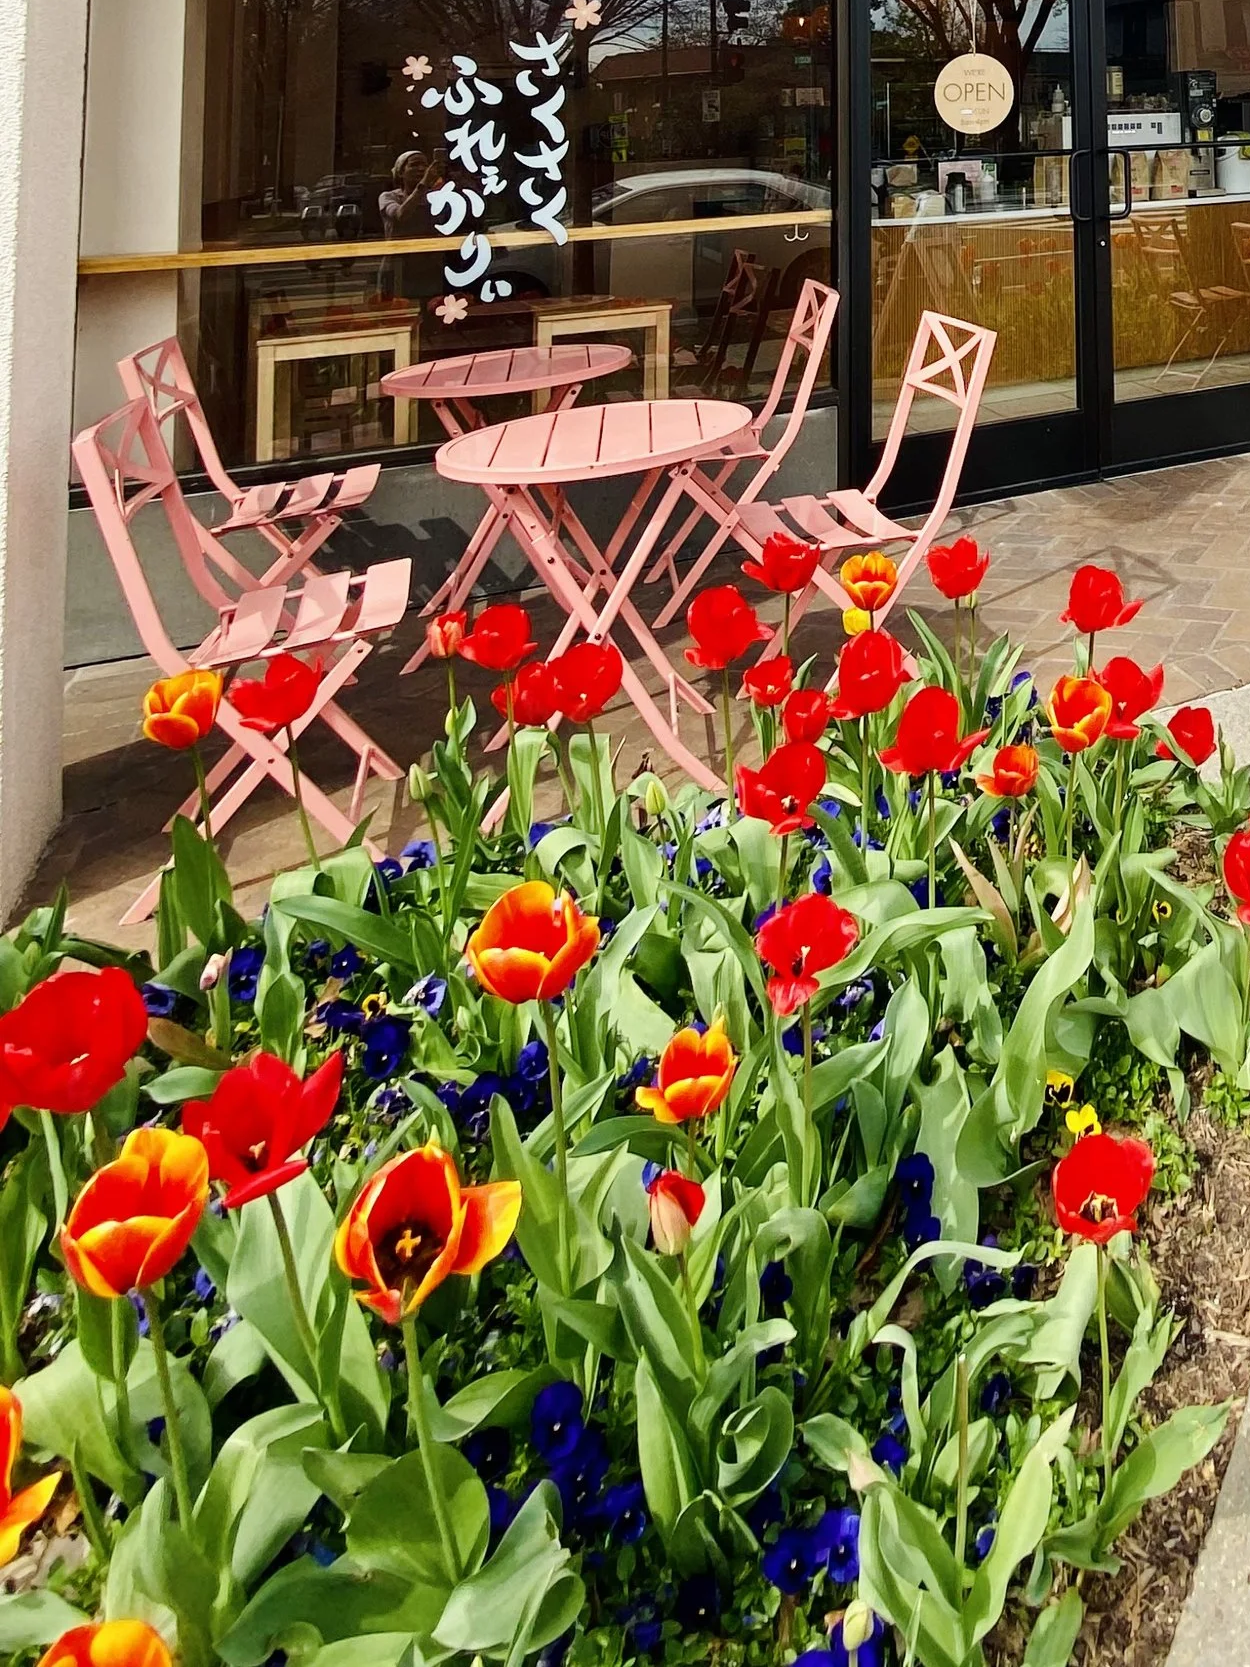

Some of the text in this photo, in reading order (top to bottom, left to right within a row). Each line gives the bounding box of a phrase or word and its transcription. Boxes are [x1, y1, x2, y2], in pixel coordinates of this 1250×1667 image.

[508, 31, 570, 247] さくさく
[943, 82, 1006, 103] OPEN
